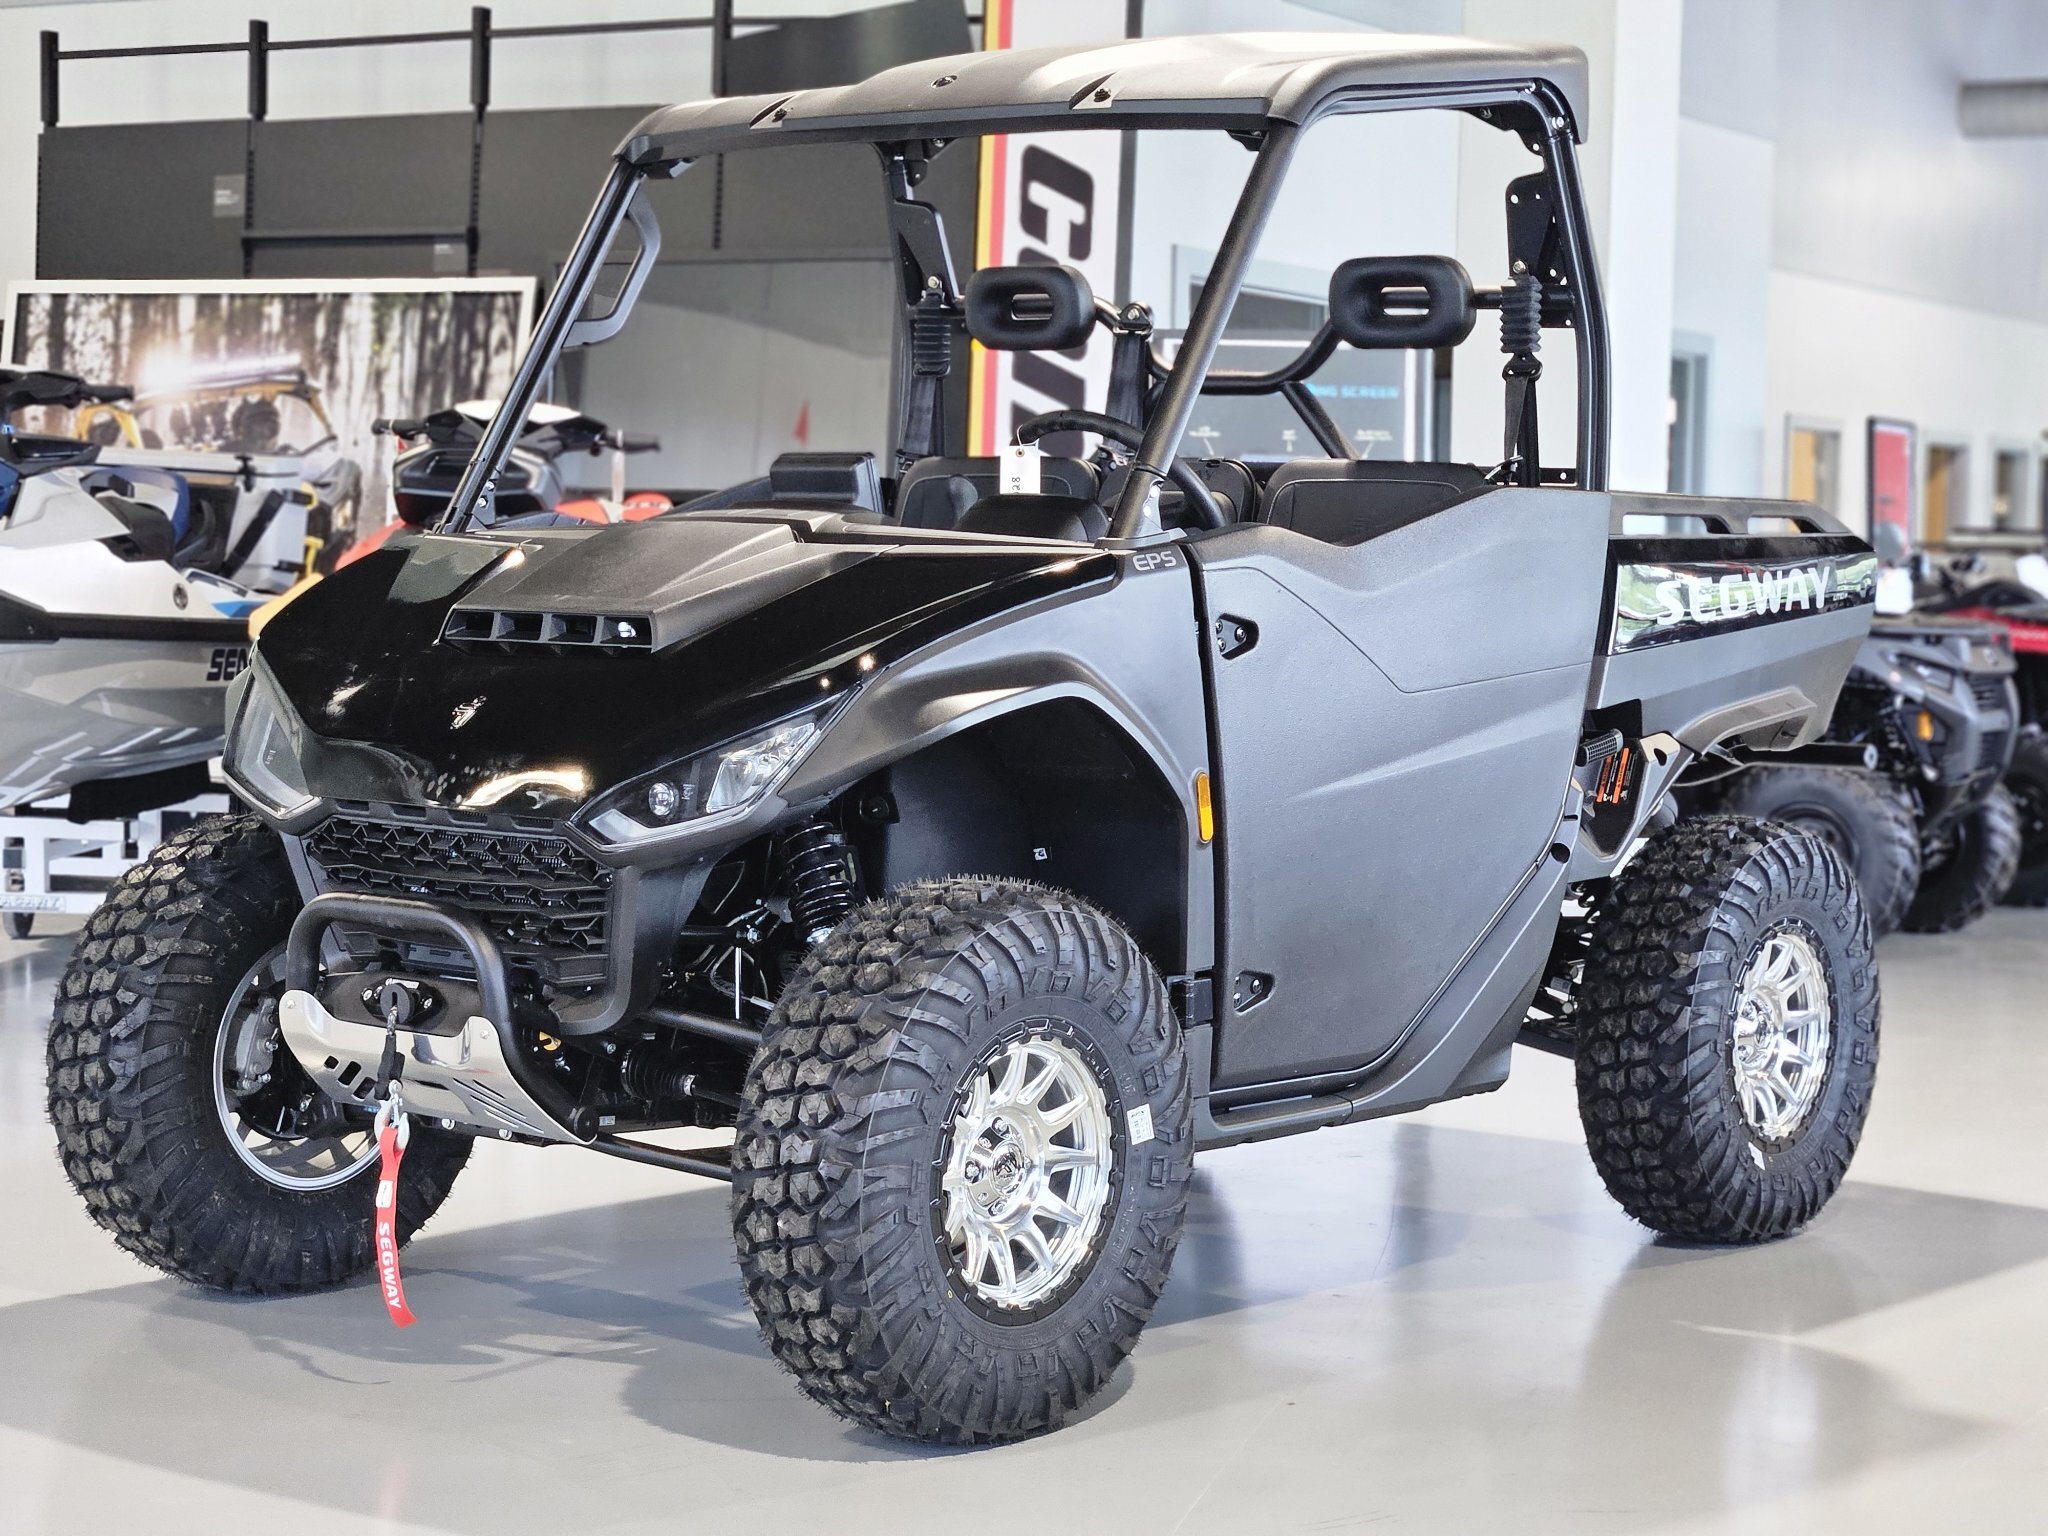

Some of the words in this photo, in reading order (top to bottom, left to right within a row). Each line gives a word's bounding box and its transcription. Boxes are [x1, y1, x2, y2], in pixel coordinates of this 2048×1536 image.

[1132, 550, 1177, 571] EPS
[1655, 566, 1831, 626] SEGWAY
[378, 1221, 402, 1309] SEGWAY
